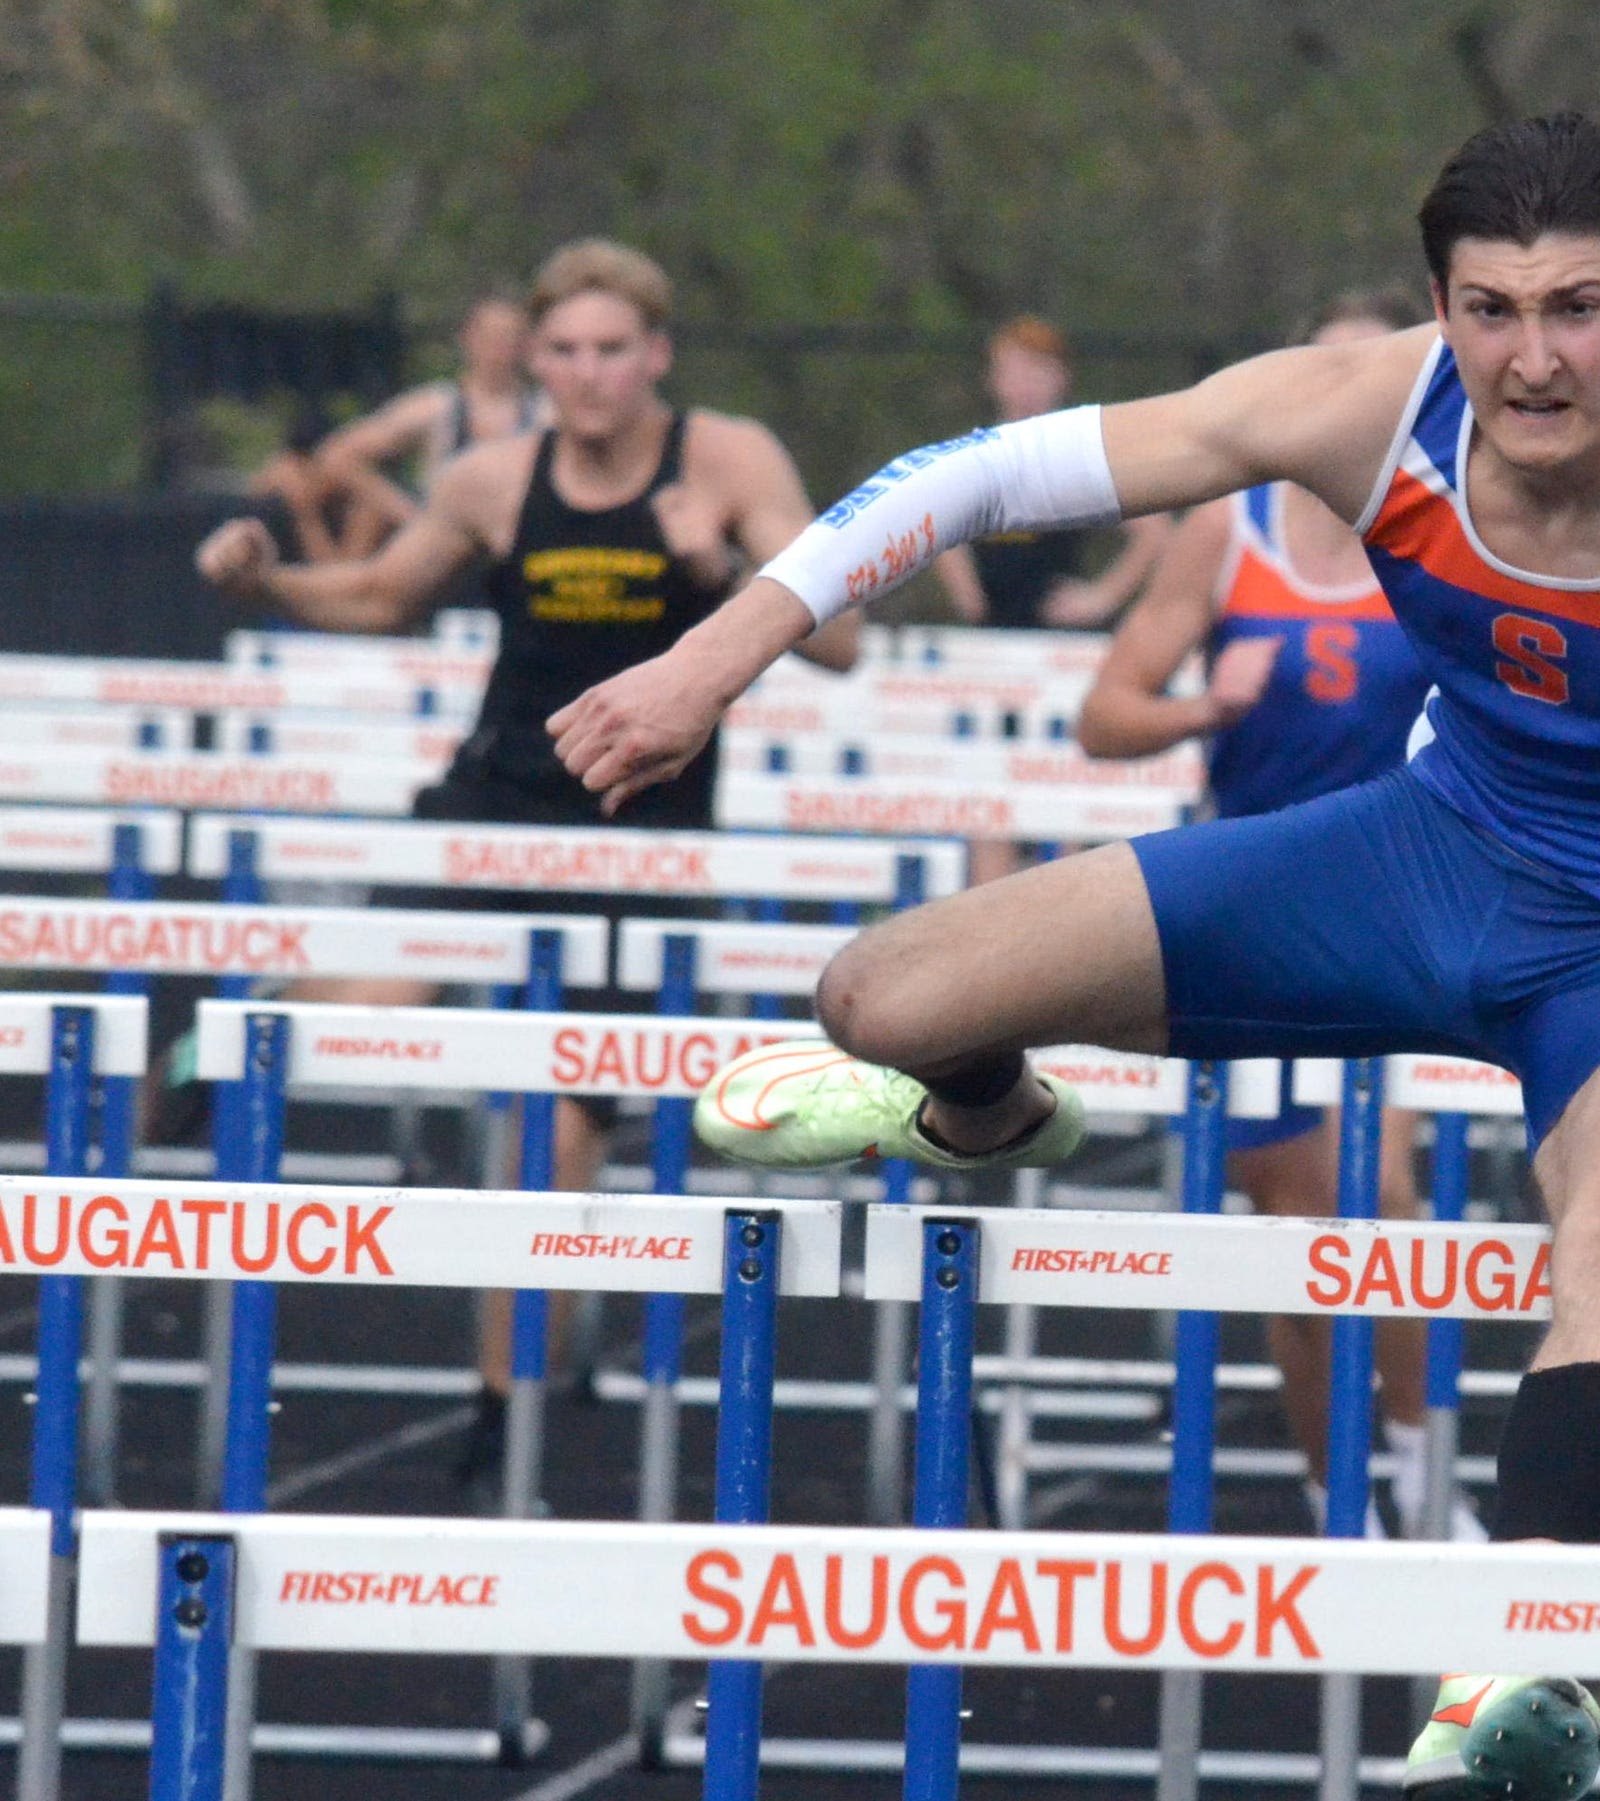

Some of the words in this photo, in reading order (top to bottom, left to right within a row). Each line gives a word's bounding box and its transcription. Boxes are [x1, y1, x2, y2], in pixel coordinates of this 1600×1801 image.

[1305, 621, 1359, 702] S
[1492, 612, 1570, 705] S
[0, 911, 311, 971] SAUGATUCK
[530, 1233, 603, 1258] FIRST
[1011, 1248, 1083, 1272] FIRST
[1089, 1251, 1173, 1276] PLACE
[280, 1571, 381, 1605] FIRST
[387, 1573, 499, 1607] PLACE
[682, 1549, 1322, 1659] SAUGATUCK
